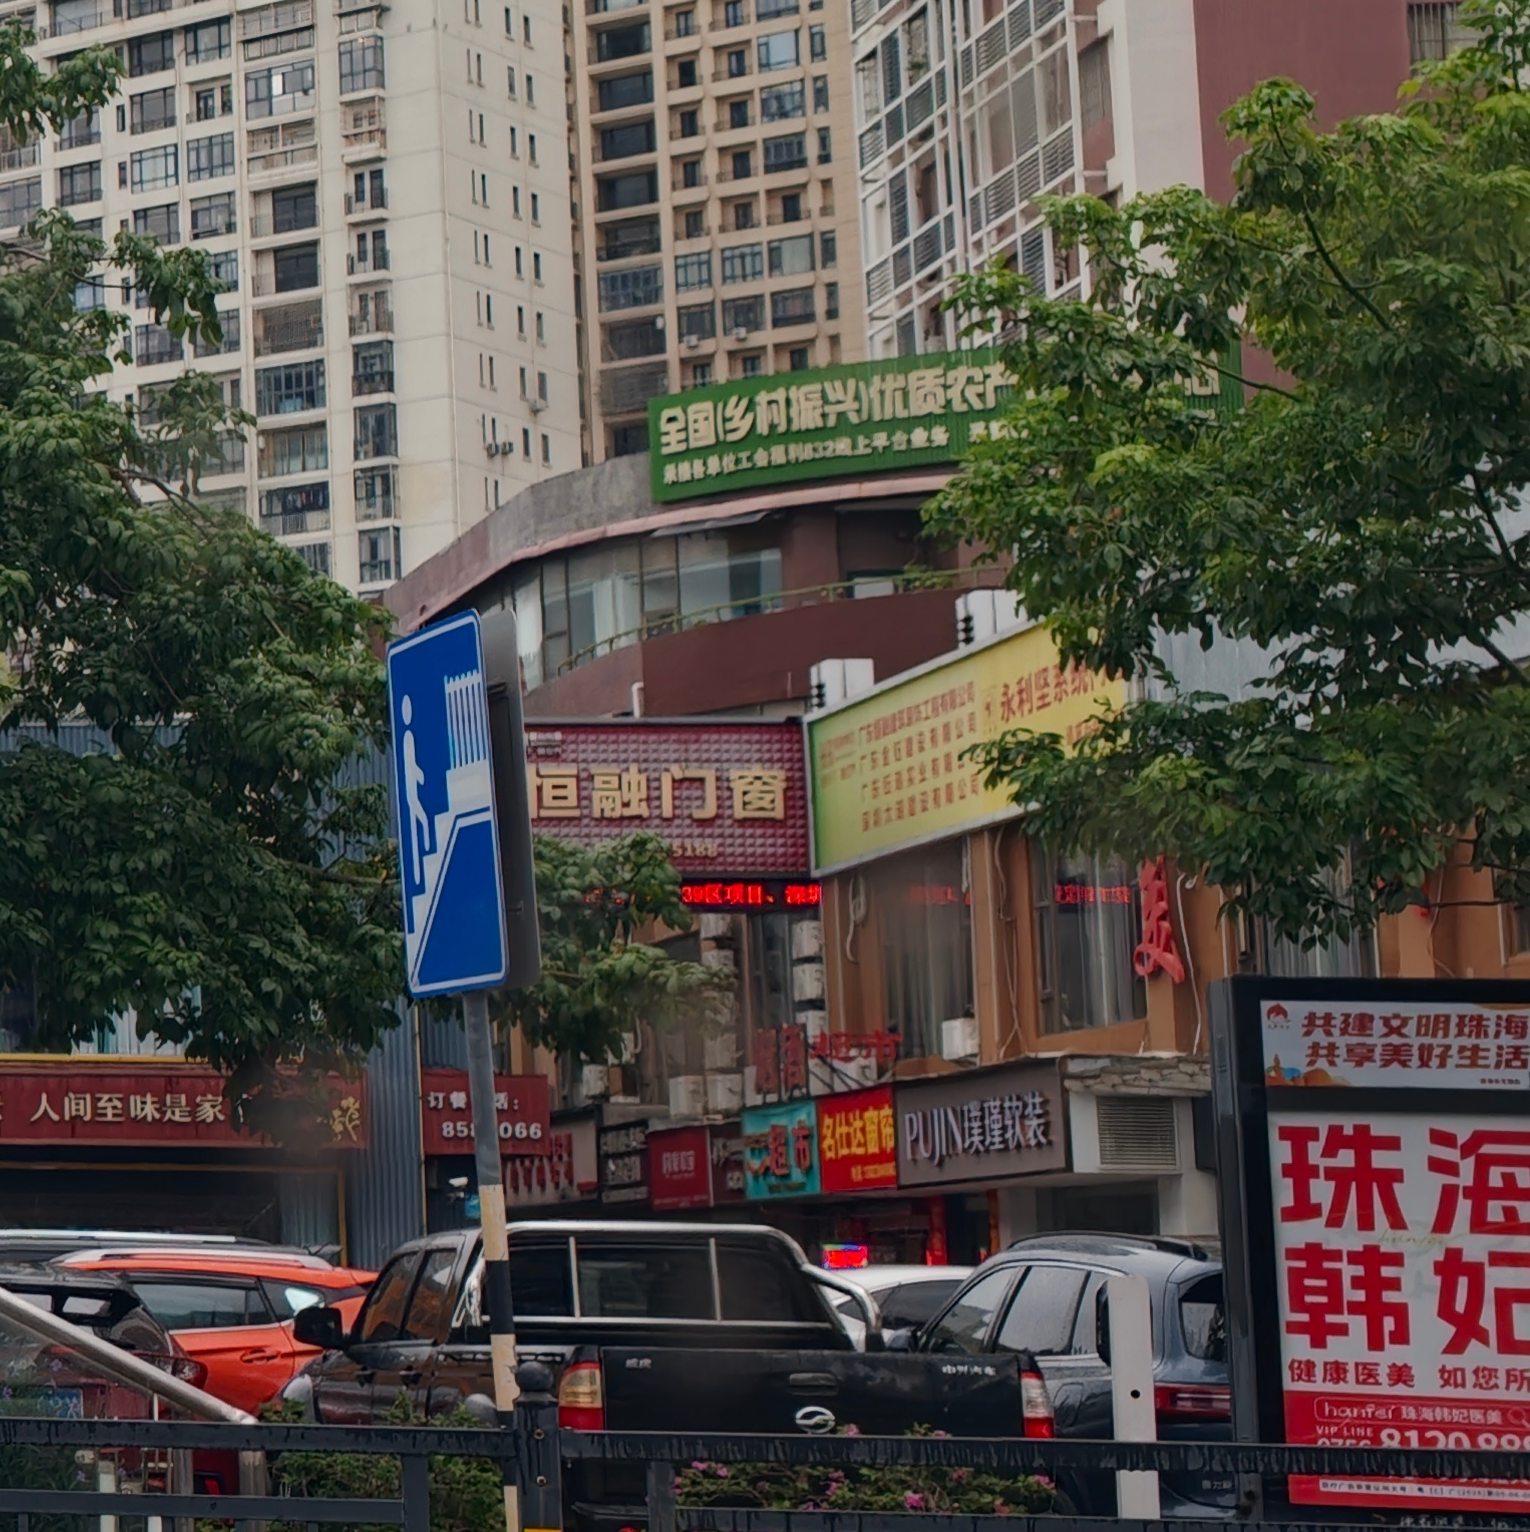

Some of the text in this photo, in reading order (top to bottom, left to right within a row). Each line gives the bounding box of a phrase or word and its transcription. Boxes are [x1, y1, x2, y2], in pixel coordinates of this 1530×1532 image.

[528, 762, 787, 820] 恒融门窗
[1302, 1011, 1529, 1040] 共建文明珠海
[1306, 1041, 1530, 1071] 共享美好生活
[441, 1121, 542, 1140] 85066
[822, 1105, 895, 1161] 名仕达窗帘
[1278, 1123, 1530, 1236] 珠海
[1285, 1242, 1530, 1355] 韩妃
[1288, 1358, 1415, 1388] 健康医美
[1400, 1405, 1503, 1425] 珠海韩妃医美
[1315, 1424, 1374, 1438] VIP LINE
